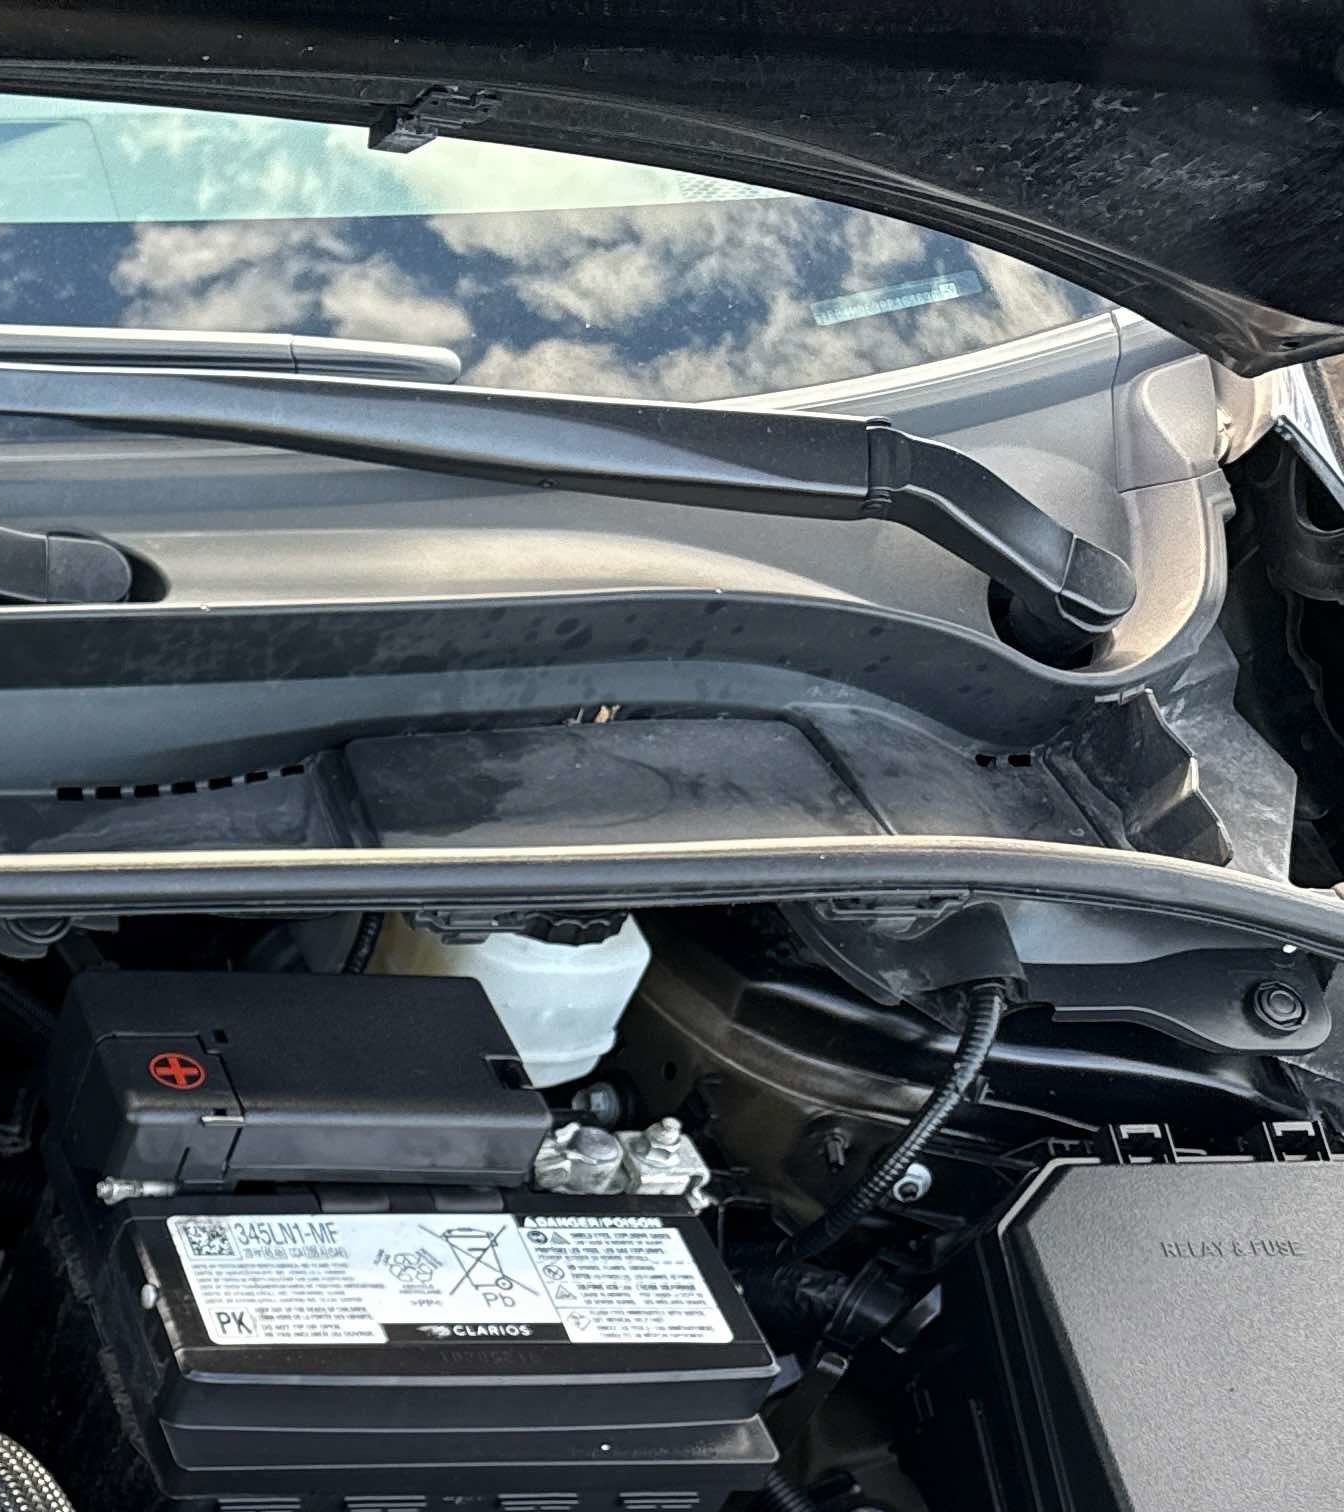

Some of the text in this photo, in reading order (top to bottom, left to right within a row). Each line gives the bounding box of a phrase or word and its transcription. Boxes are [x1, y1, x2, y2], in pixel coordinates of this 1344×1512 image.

[234, 1222, 340, 1246] 345LN1-MF
[1160, 1239, 1306, 1257] RELAY & FUSE
[482, 1292, 516, 1308] Pb
[215, 1310, 254, 1335] PK
[453, 1325, 534, 1337] CLARIOS
